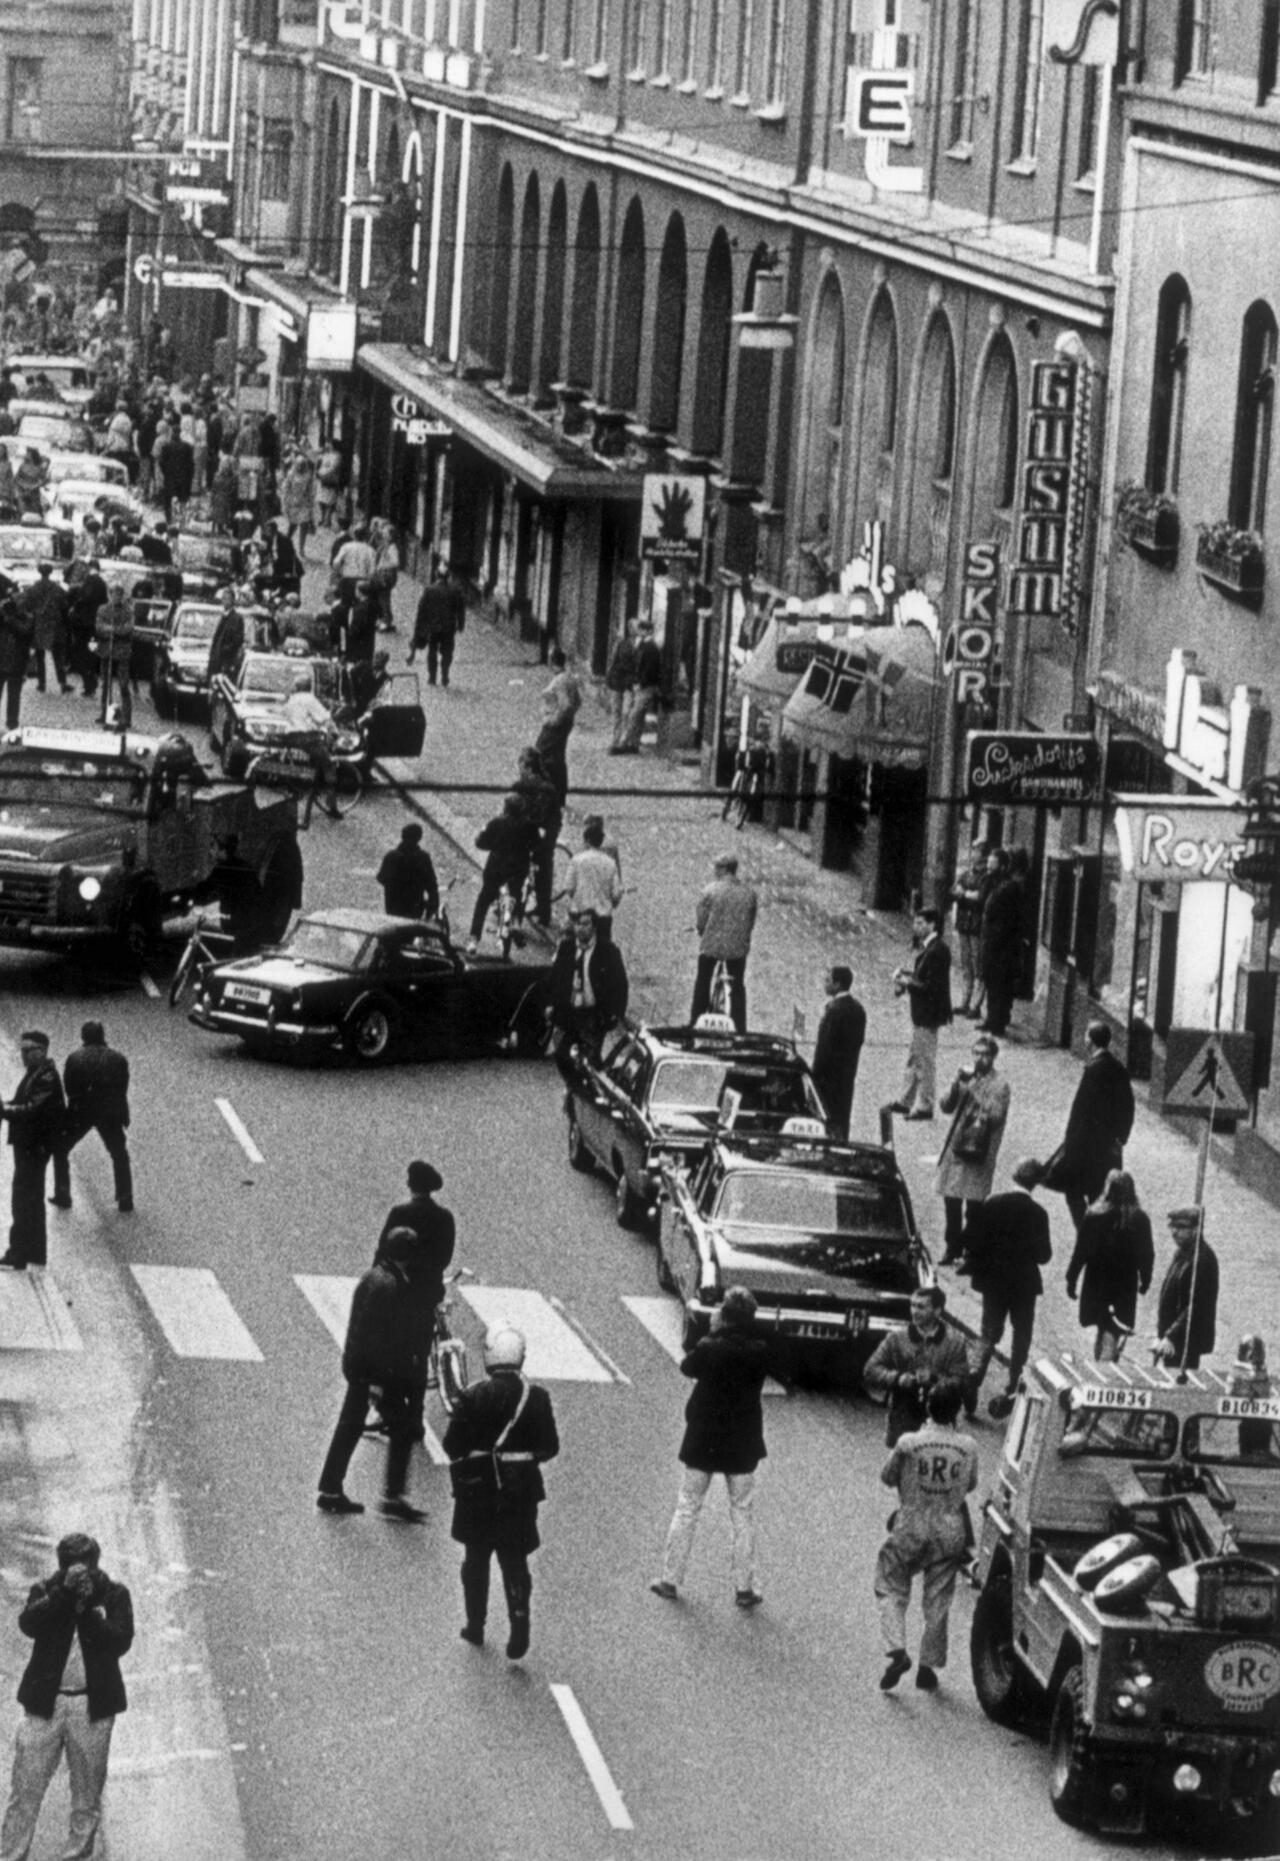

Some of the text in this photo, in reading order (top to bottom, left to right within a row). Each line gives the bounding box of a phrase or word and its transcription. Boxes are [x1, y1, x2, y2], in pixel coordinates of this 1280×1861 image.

[957, 543, 996, 703] SKOR
[790, 1121, 821, 1134] TAXI
[918, 1456, 961, 1482] BRC
[1222, 1657, 1273, 1689] BRC
